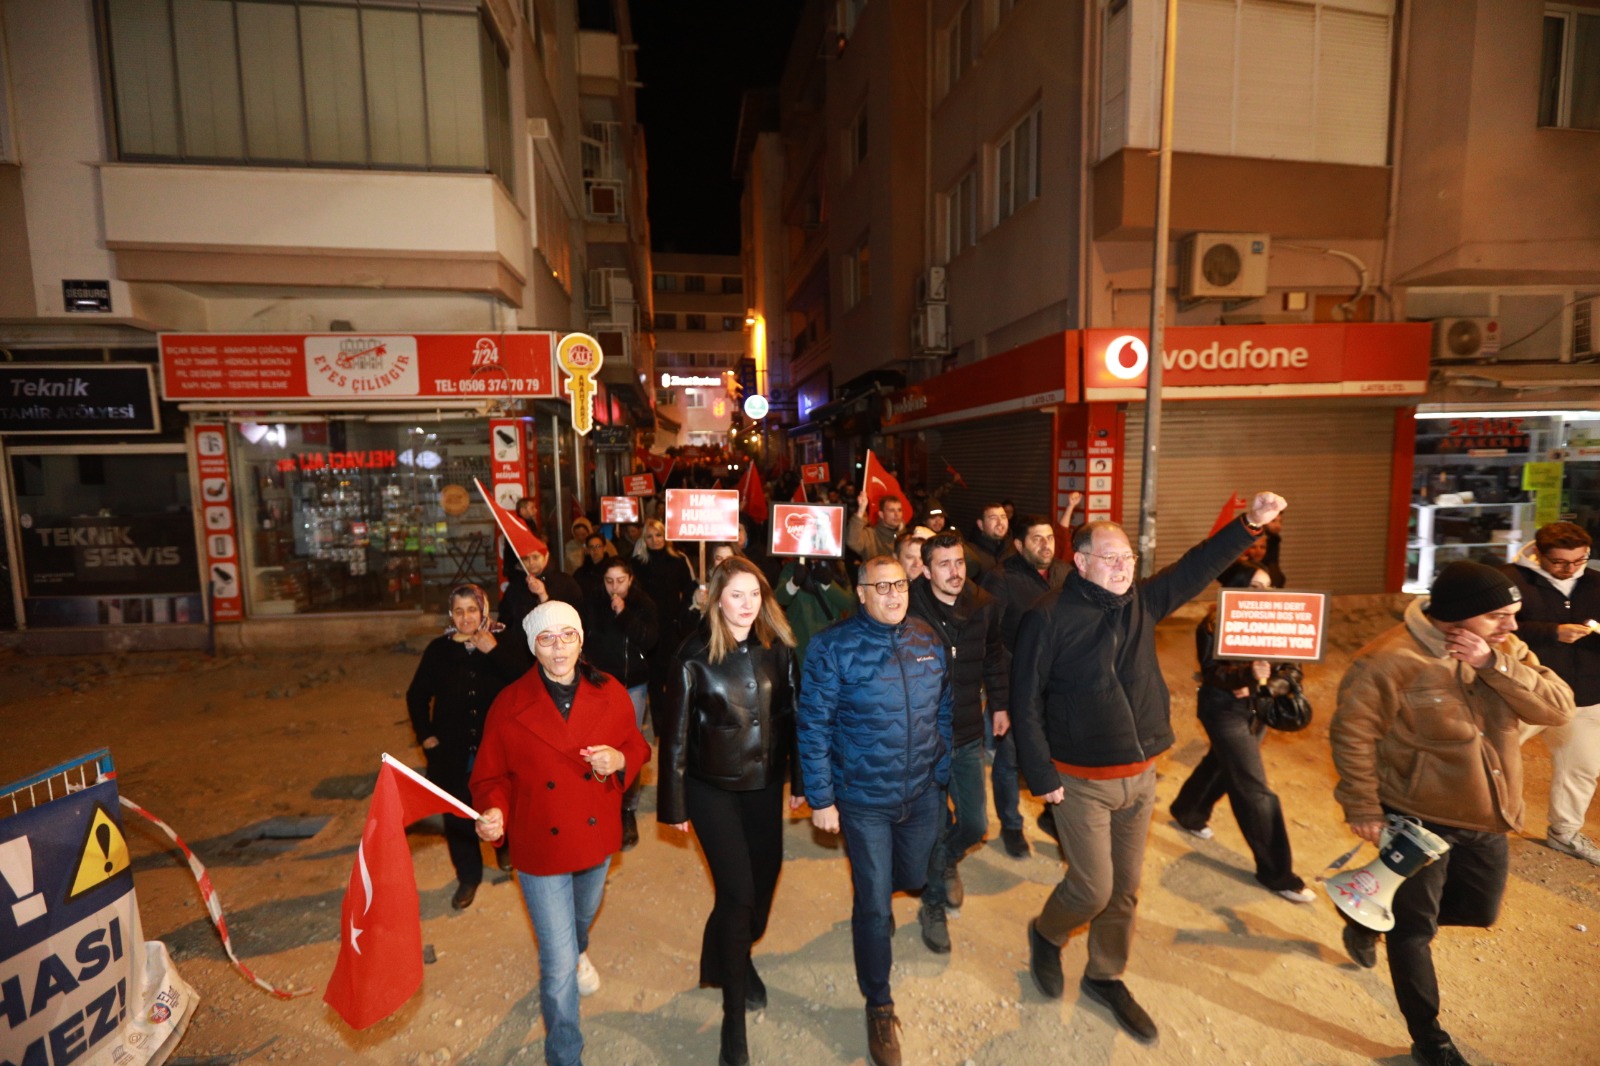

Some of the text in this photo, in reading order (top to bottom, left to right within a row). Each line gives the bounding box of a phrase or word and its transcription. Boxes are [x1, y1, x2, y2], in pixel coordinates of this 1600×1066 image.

[472, 348, 498, 366] 7/24
[1162, 341, 1309, 370] vodafone
[313, 354, 409, 393] EFES ÇİLİNGİR
[10, 378, 90, 397] Teknik
[434, 378, 540, 392] TEL: 0506 374 70 79
[0, 403, 135, 419] TAMİR ATÖLYESİ
[689, 494, 716, 507] HAK
[36, 526, 133, 547] TEKNİK
[84, 545, 181, 567] SERVİS
